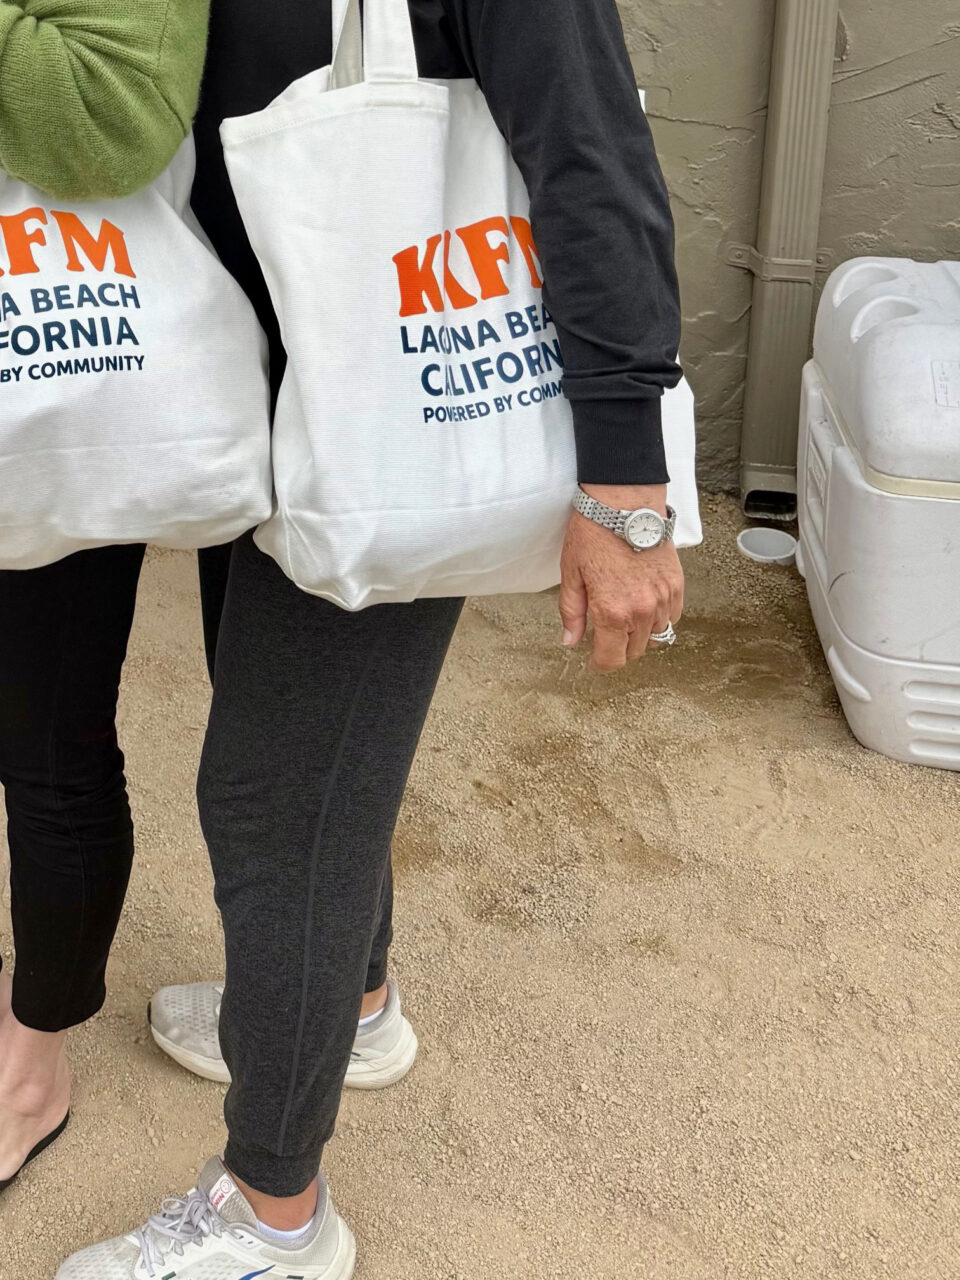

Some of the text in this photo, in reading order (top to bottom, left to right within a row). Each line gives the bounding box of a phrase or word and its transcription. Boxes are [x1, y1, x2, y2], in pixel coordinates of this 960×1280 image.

[30, 282, 141, 314] BEACH
[0, 366, 24, 383] BY
[28, 355, 145, 380] COMMUNITY
[493, 394, 514, 413] BY
